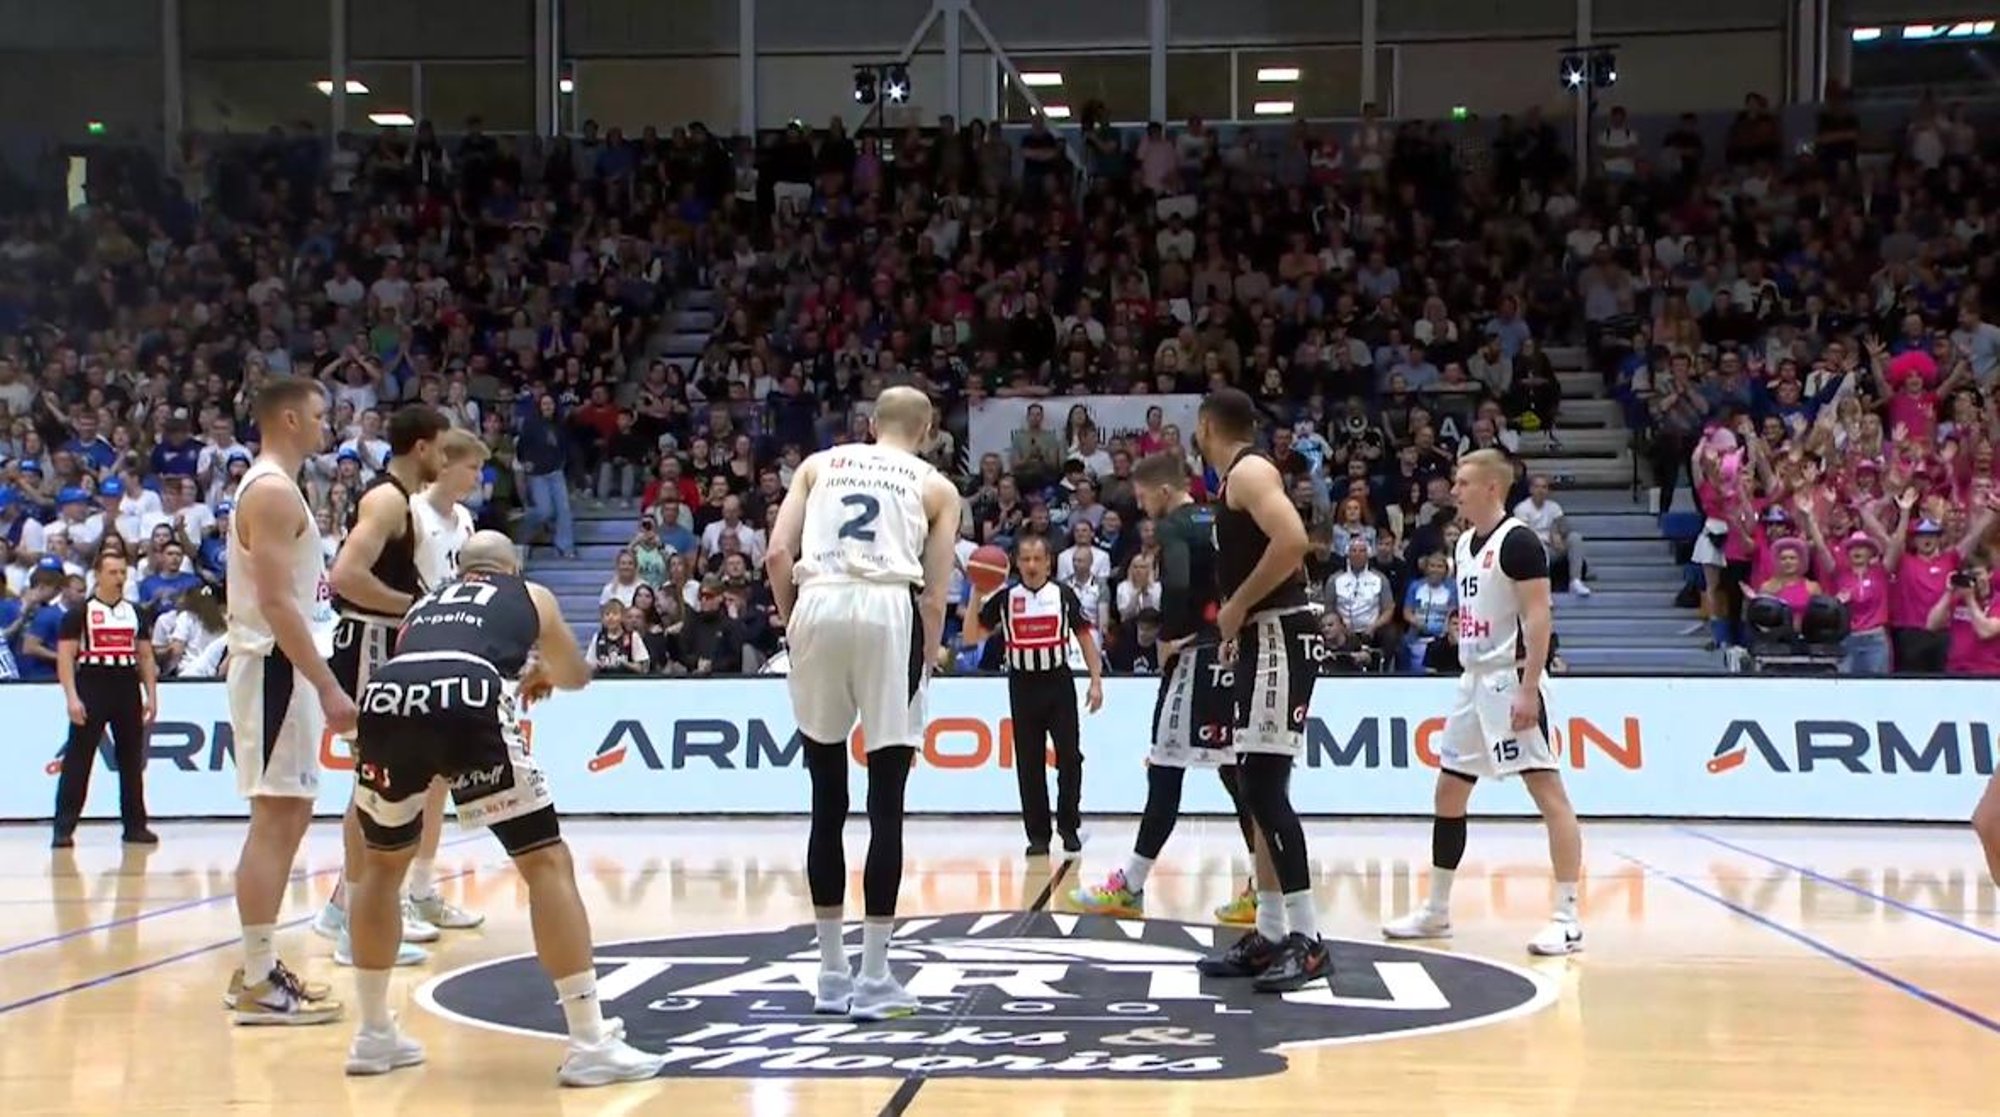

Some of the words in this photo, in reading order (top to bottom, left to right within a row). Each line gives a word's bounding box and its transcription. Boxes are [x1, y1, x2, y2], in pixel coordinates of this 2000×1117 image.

[838, 493, 880, 542] 2
[1461, 576, 1477, 598] 15
[412, 610, 484, 628] A-pellet
[1493, 739, 1519, 763] 15
[667, 1023, 1068, 1046] Maks
[1100, 1026, 1216, 1046] &
[660, 1046, 1223, 1073] Moorits
